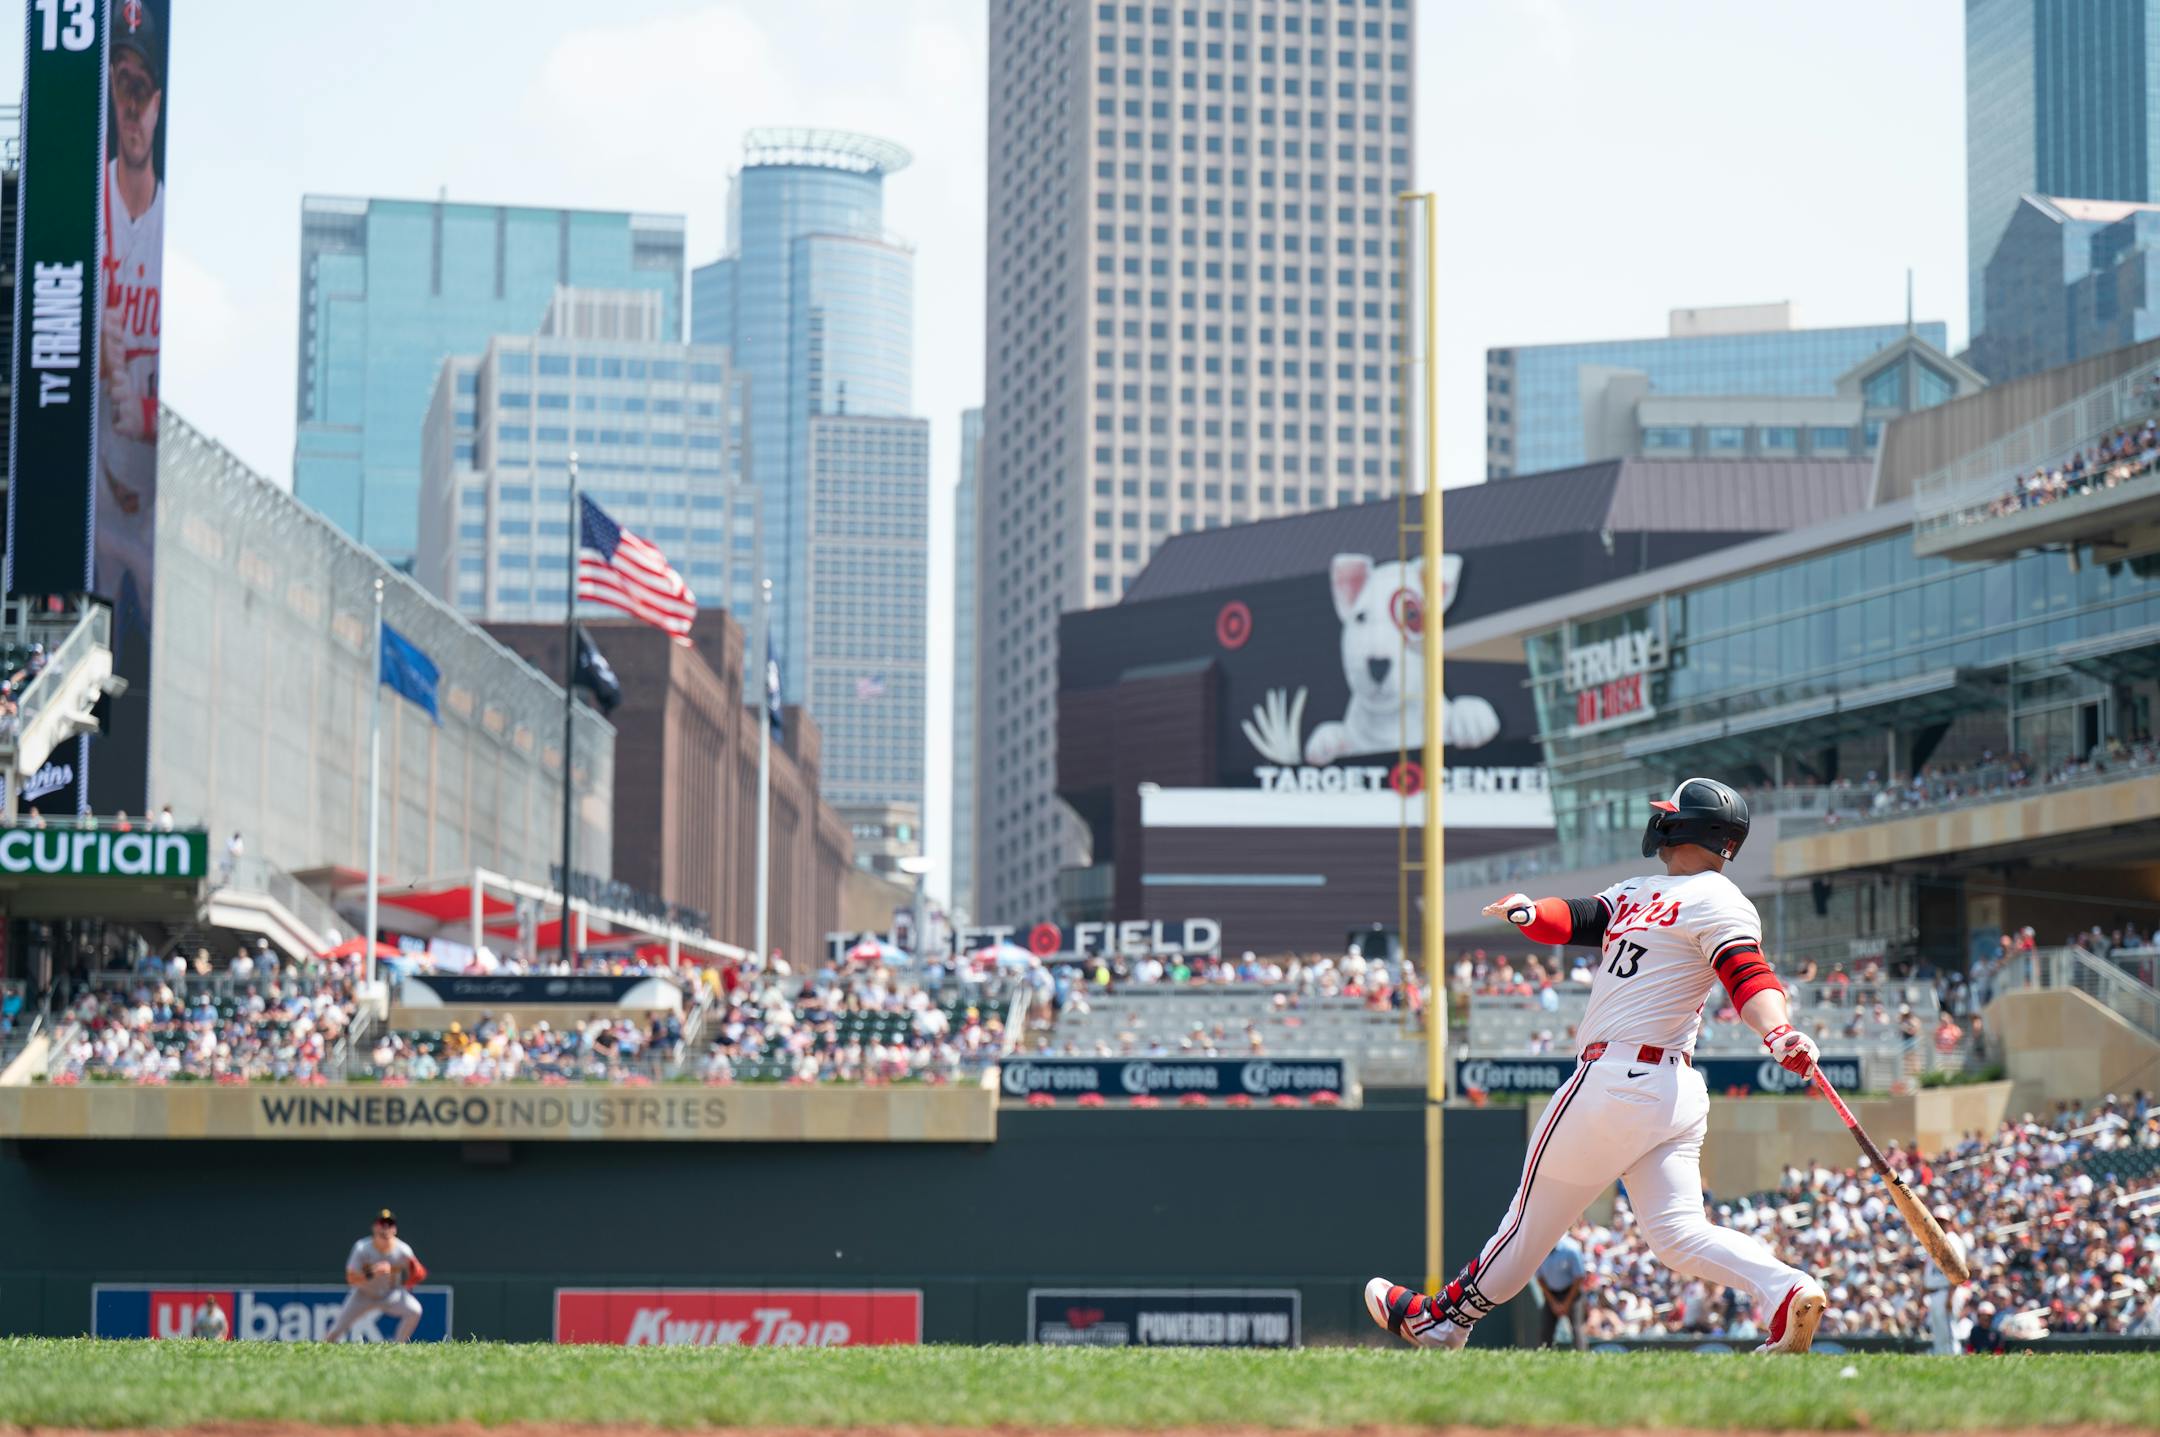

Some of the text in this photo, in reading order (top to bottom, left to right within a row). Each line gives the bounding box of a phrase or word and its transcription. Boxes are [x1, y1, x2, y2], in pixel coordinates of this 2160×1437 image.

[35, 0, 95, 51] 13
[31, 261, 83, 408] TY FRANCE
[1254, 766, 1388, 793] TARGET
[0, 830, 191, 875] curian
[1074, 917, 1222, 958] FIELD
[1607, 938, 1649, 979] 13
[1002, 1061, 1099, 1095] Corona
[1121, 1061, 1219, 1095] Corona
[1240, 1061, 1339, 1096] Corona
[1461, 1060, 1560, 1094] Corona
[261, 1095, 728, 1129] WINNEBAGO INDUSTRIES
